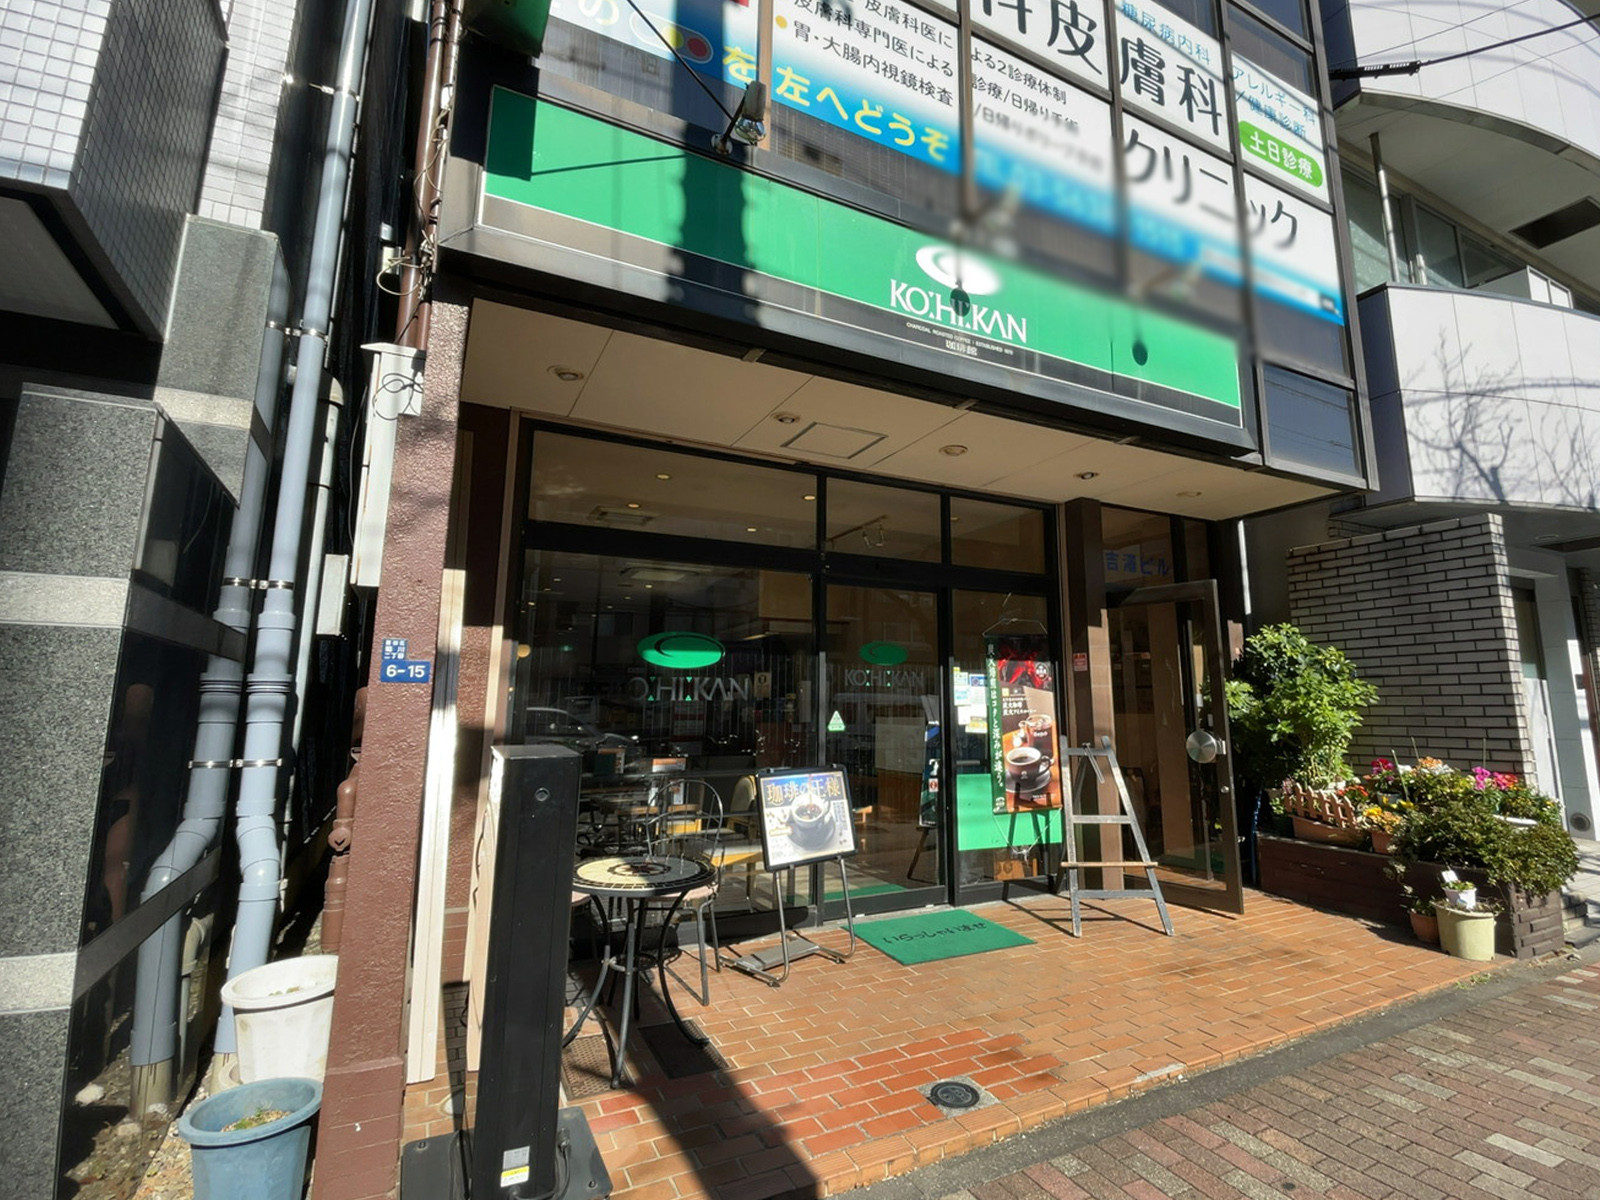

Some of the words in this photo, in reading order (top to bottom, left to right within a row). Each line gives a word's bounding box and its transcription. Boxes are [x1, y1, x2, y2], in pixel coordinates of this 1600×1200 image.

[1122, 2, 1210, 66] 糖尿病内科
[776, 66, 949, 162] 左へどうぞ
[1120, 37, 1222, 136] 膚科
[1231, 64, 1316, 126] アレルギー科
[1249, 130, 1313, 181] 土日診療
[386, 664, 426, 679] 6-15
